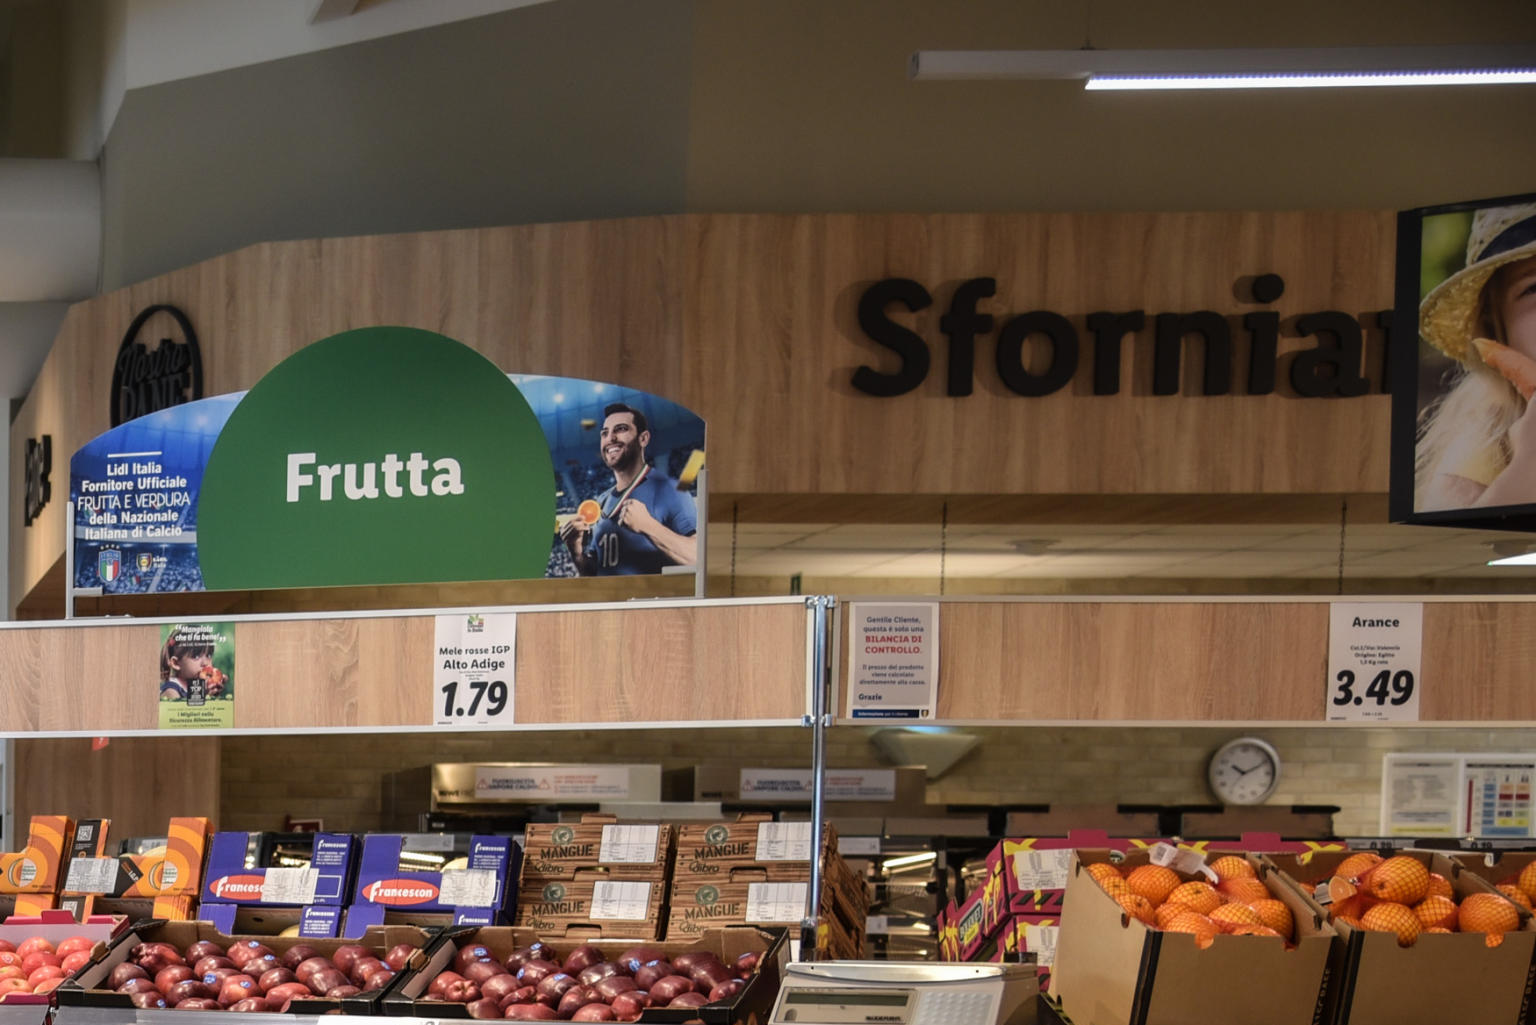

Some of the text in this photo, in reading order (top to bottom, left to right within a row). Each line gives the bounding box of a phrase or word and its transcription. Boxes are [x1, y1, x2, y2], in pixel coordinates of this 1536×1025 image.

[107, 462, 162, 477] Lidl Italia
[286, 451, 464, 503] Frutta
[82, 476, 187, 492] Fornitore Ufficiale
[78, 492, 190, 511] FRUTTA E VERDURA
[89, 510, 178, 525] della Nazionale
[85, 525, 182, 540] Italiana di Calcio
[599, 534, 618, 567] 10
[894, 616, 920, 624] Cliente,
[1352, 617, 1400, 627] Arance
[492, 646, 510, 654] IGP
[444, 658, 505, 671] Alto Adige
[1333, 670, 1414, 706] 3.49
[442, 681, 508, 717] 1.79
[540, 844, 594, 860] MANGUE
[694, 842, 750, 860] MANGUE
[370, 880, 433, 902] Francescon
[532, 901, 584, 916] MANGUE
[684, 904, 740, 920] MANGUE
